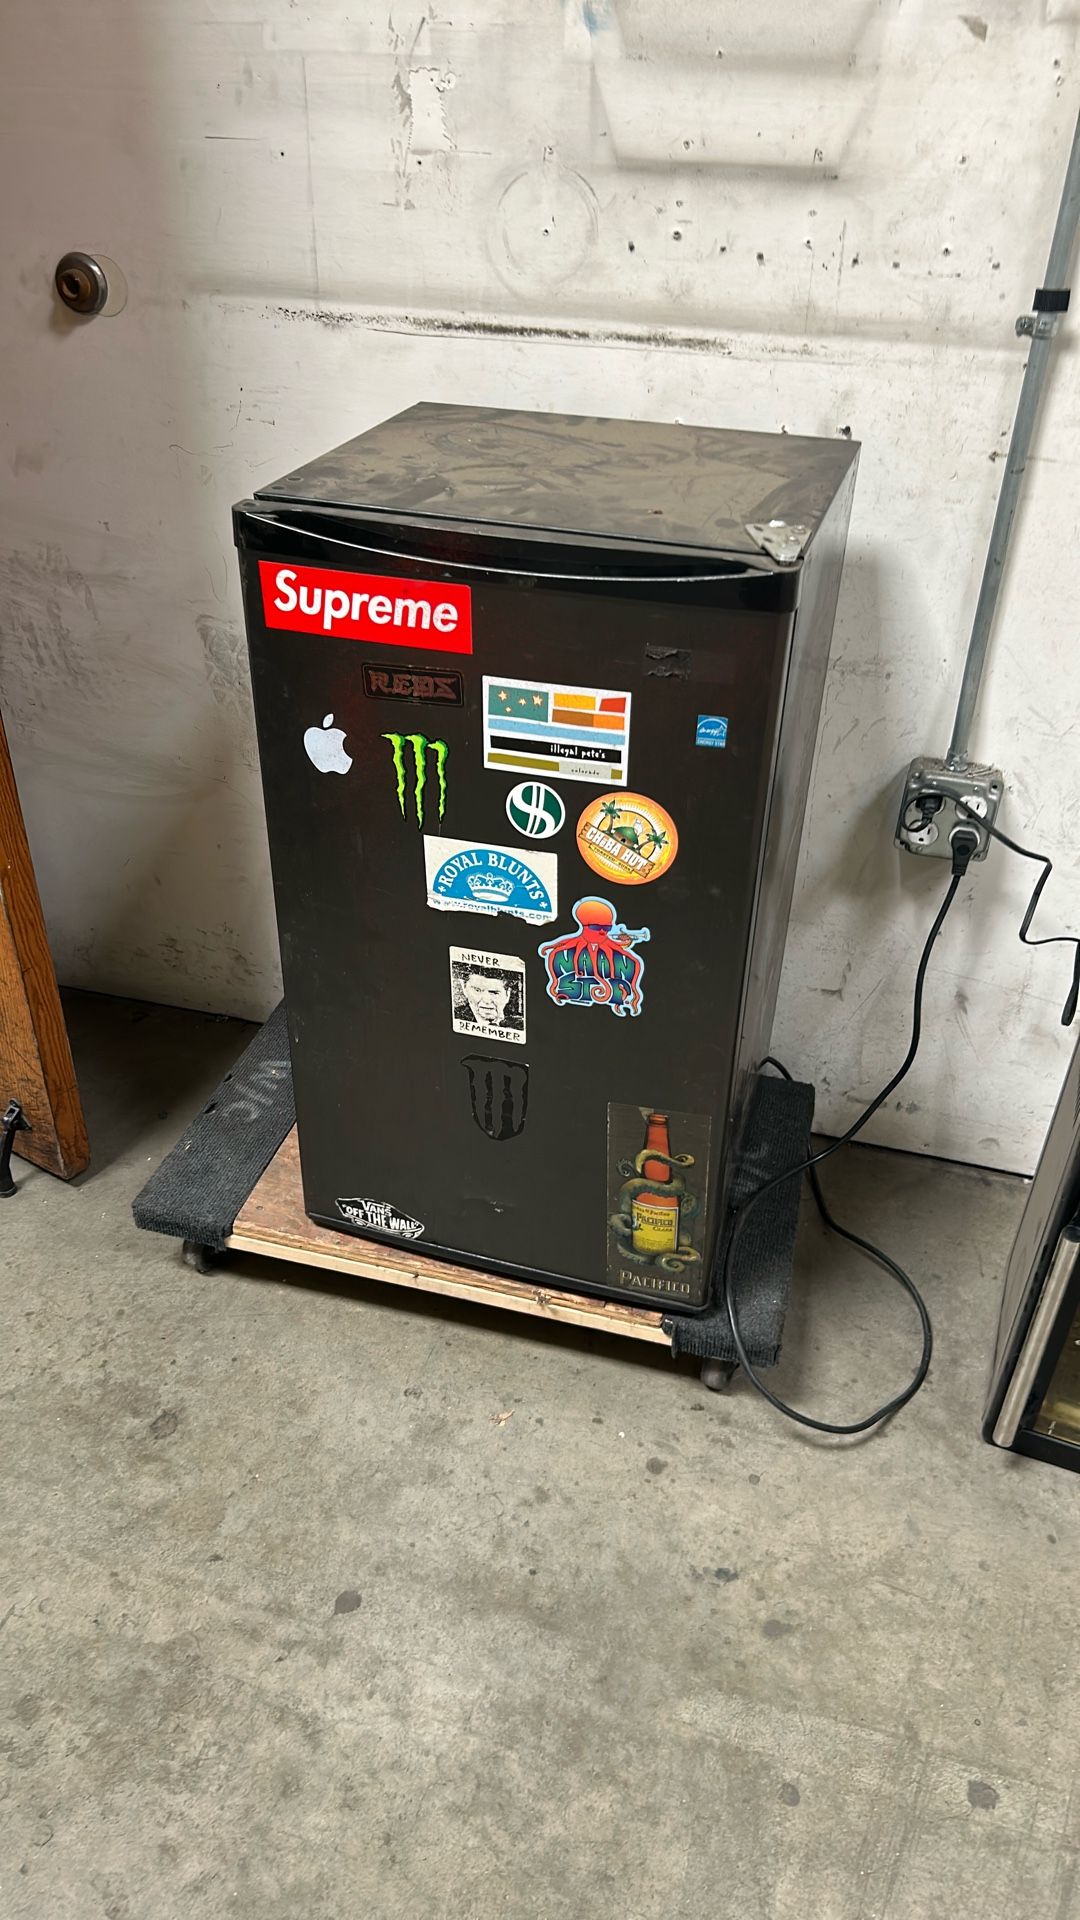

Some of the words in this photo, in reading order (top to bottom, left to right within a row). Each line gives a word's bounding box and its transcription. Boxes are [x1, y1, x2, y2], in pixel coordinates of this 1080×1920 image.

[274, 569, 458, 632] Supreme
[550, 743, 578, 757] illegal
[581, 749, 606, 759] pete's
[571, 767, 600, 775] colorado
[620, 848, 648, 870] HUT
[438, 852, 482, 888] ROYAL
[488, 853, 545, 900] BLUNTS
[461, 953, 500, 967] NEVER
[553, 946, 636, 983] NAAN
[360, 1200, 392, 1217] VANS
[366, 1211, 388, 1228] THE
